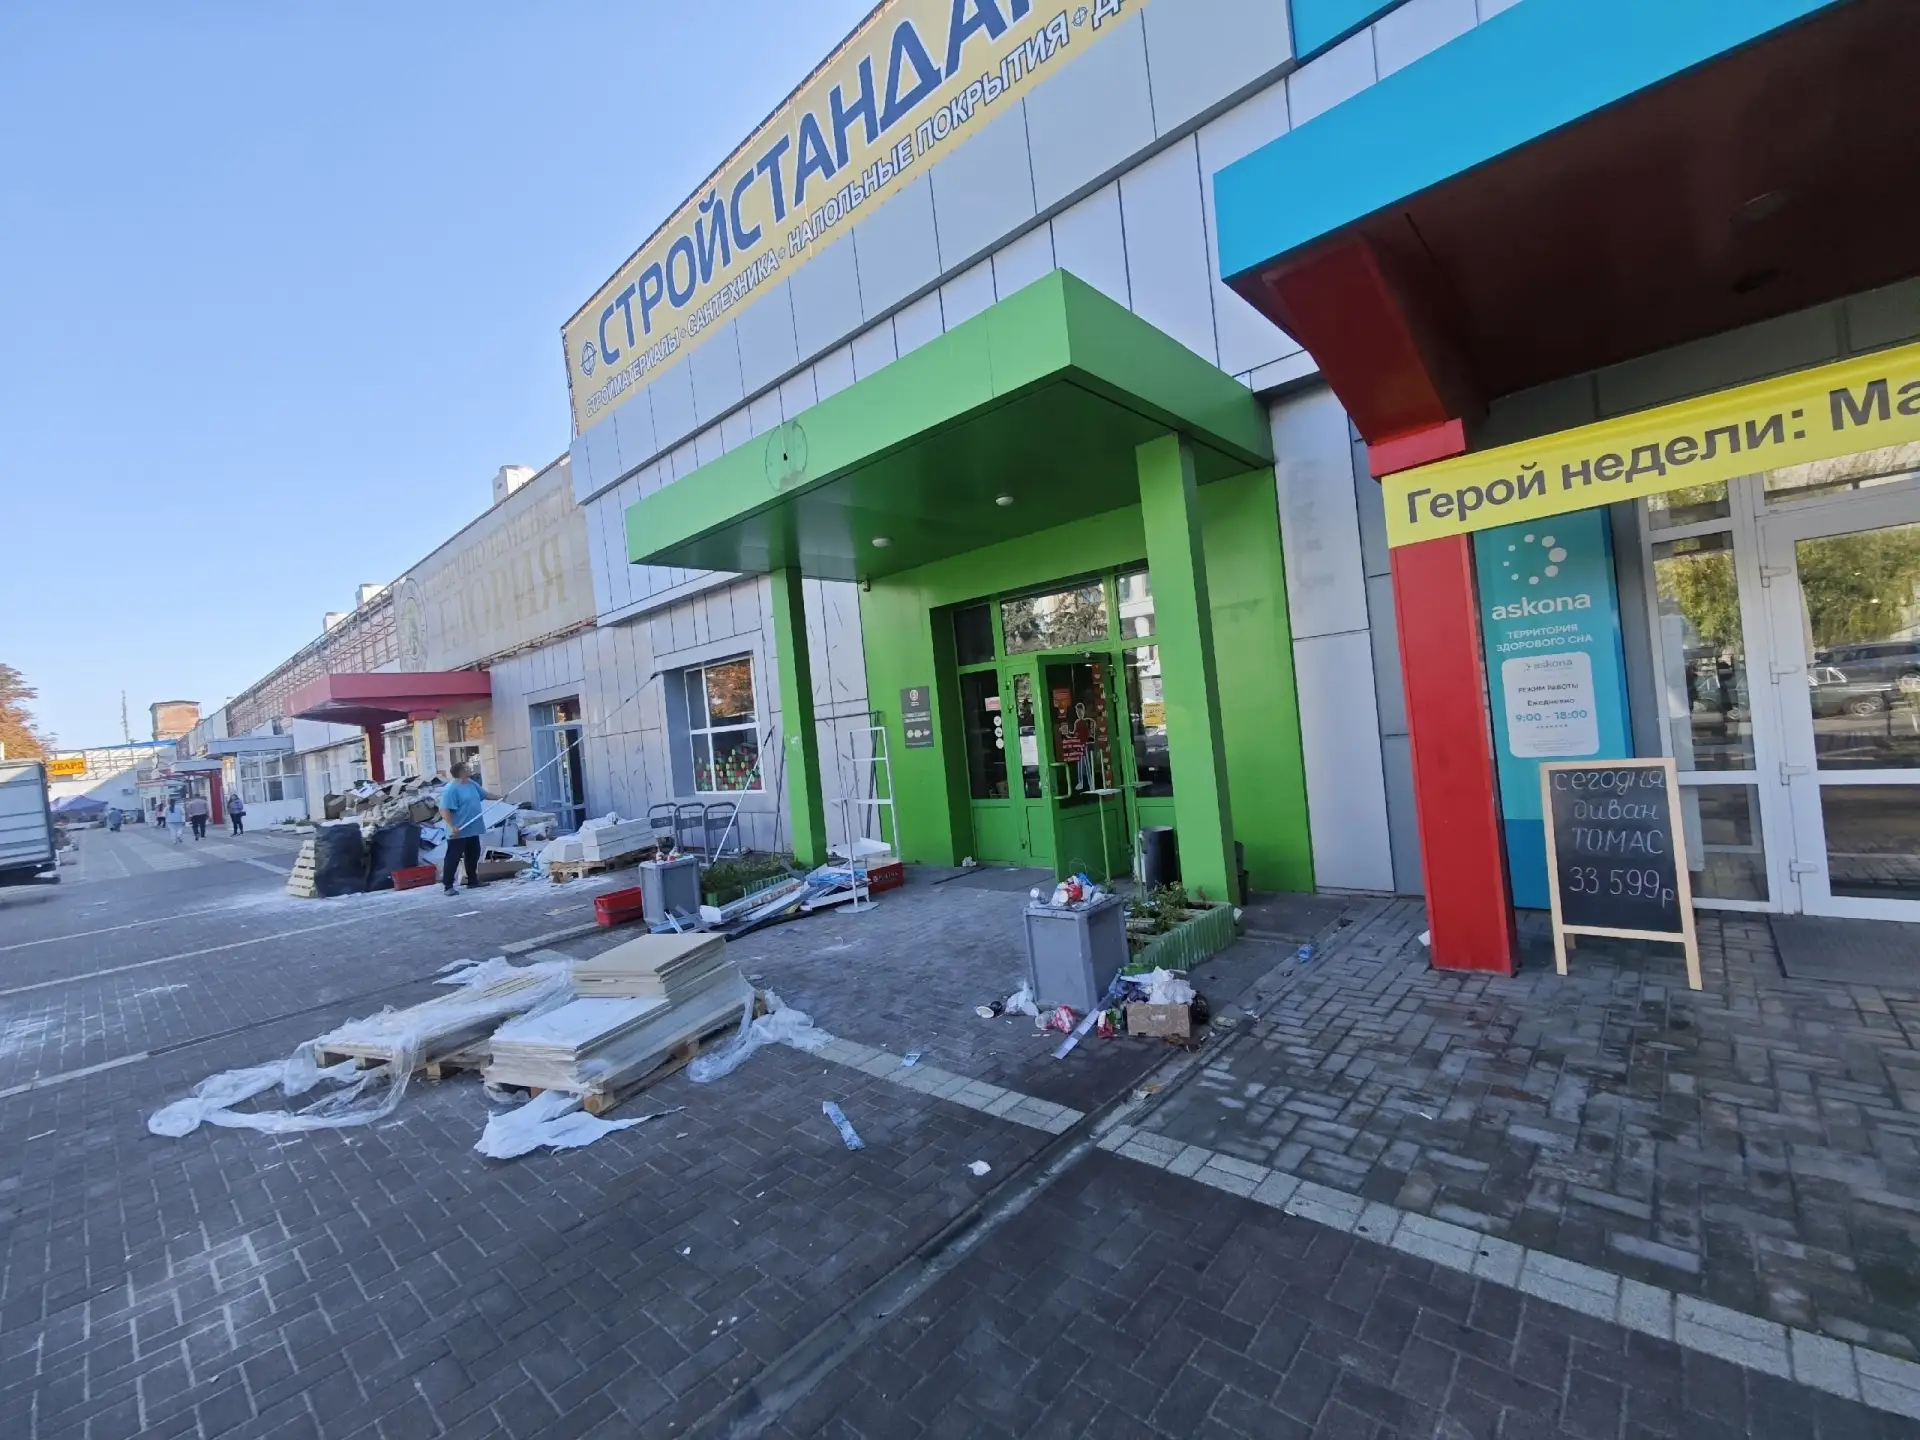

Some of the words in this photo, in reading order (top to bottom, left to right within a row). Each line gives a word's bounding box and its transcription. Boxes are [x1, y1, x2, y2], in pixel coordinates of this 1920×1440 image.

[599, 0, 1031, 367] СТРОЙСТАНДА
[586, 327, 680, 418] СТРОЙМАТЕРИАЛЫ
[686, 247, 780, 338] САНТЕХНИКА
[787, 133, 915, 258] НАПОЛЬНЫЕ
[915, 9, 1070, 157] ПОКРЫТИЯ
[1407, 462, 1547, 523] Герой
[1562, 409, 1806, 490] недели:
[1492, 593, 1591, 620] askona
[1496, 637, 1565, 653] ЗДОРОВОГО
[1567, 634, 1593, 645] СНА
[1507, 623, 1578, 639] ТЕРРИТОРИЯ
[1517, 686, 1546, 694] РЕЖИМ
[1547, 683, 1579, 691] РАБОТЫ
[1515, 712, 1542, 723] 9:00
[1554, 709, 1588, 720] 18:00
[1555, 770, 1667, 796] сегодня
[1574, 799, 1660, 820] диван
[1572, 827, 1664, 854] ТОМАС
[1569, 866, 1600, 894] 33
